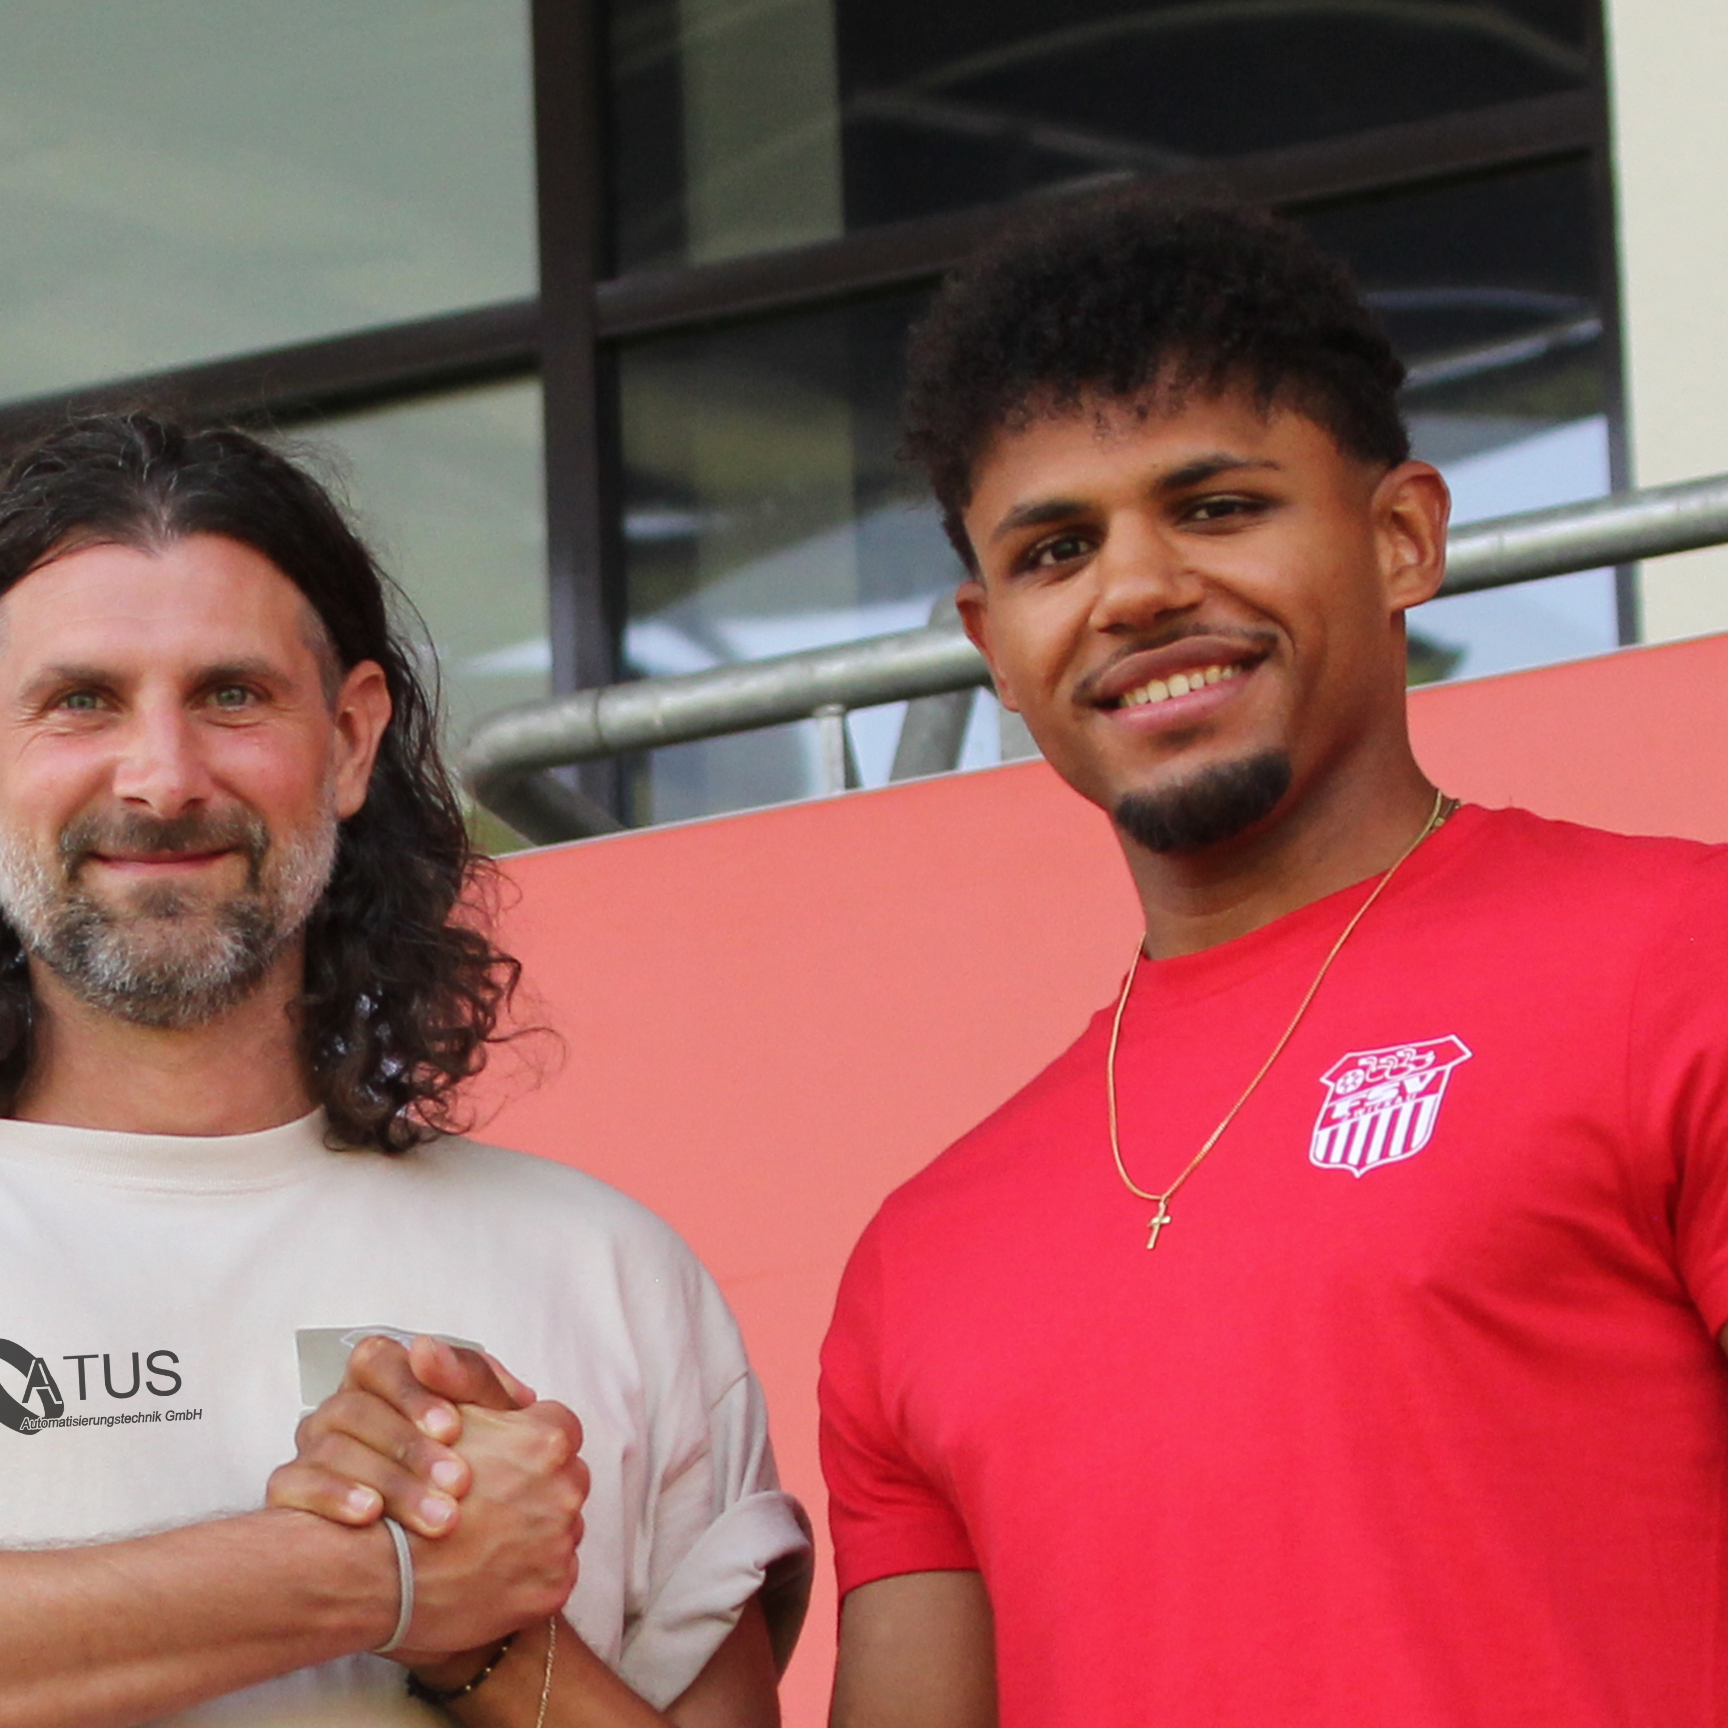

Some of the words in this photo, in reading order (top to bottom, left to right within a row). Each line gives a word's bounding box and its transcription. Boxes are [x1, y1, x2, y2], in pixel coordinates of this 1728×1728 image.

[1330, 1069, 1438, 1120] FSV
[21, 1410, 163, 1430] Automatisierungstechnik
[164, 1408, 203, 1422] GmbH
